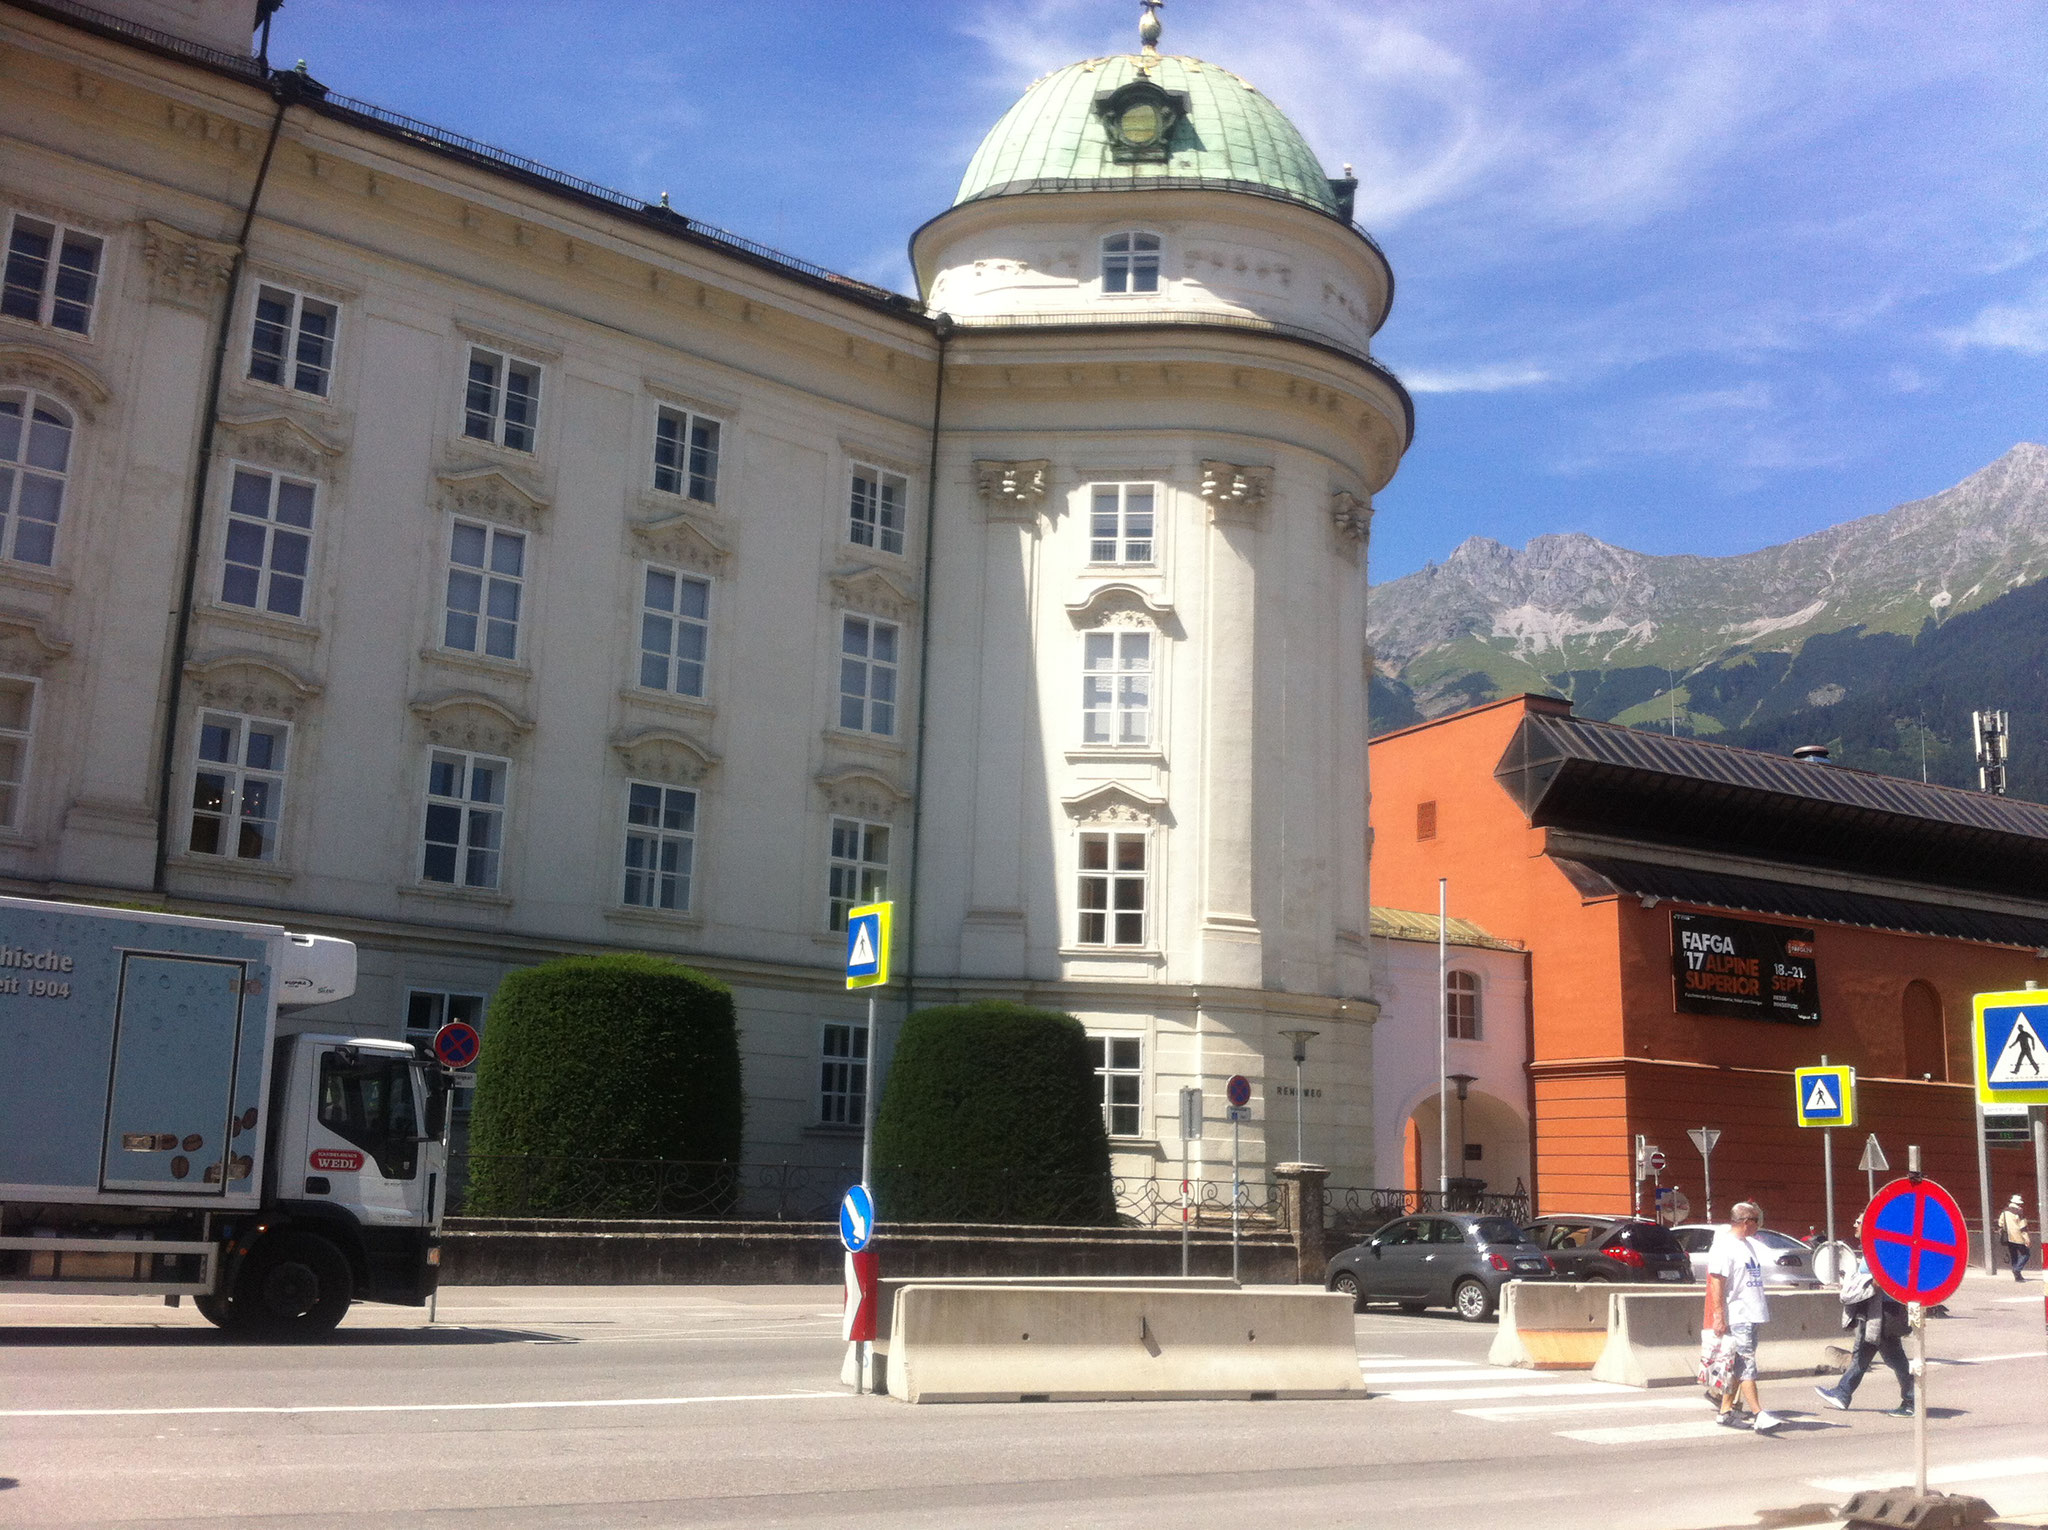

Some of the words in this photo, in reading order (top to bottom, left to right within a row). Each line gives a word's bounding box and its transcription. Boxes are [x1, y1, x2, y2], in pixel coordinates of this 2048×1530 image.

[1681, 931, 1735, 955] FAFGA
[0, 945, 73, 972] hische
[1705, 954, 1760, 977] ALPINE
[1773, 963, 1806, 979] 18.-21.
[27, 979, 70, 999] 1904
[1685, 971, 1761, 996] SUPERIOR
[1771, 975, 1804, 993] SEPT.
[1276, 1086, 1322, 1098] RENWEG
[318, 1158, 357, 1169] WEDL
